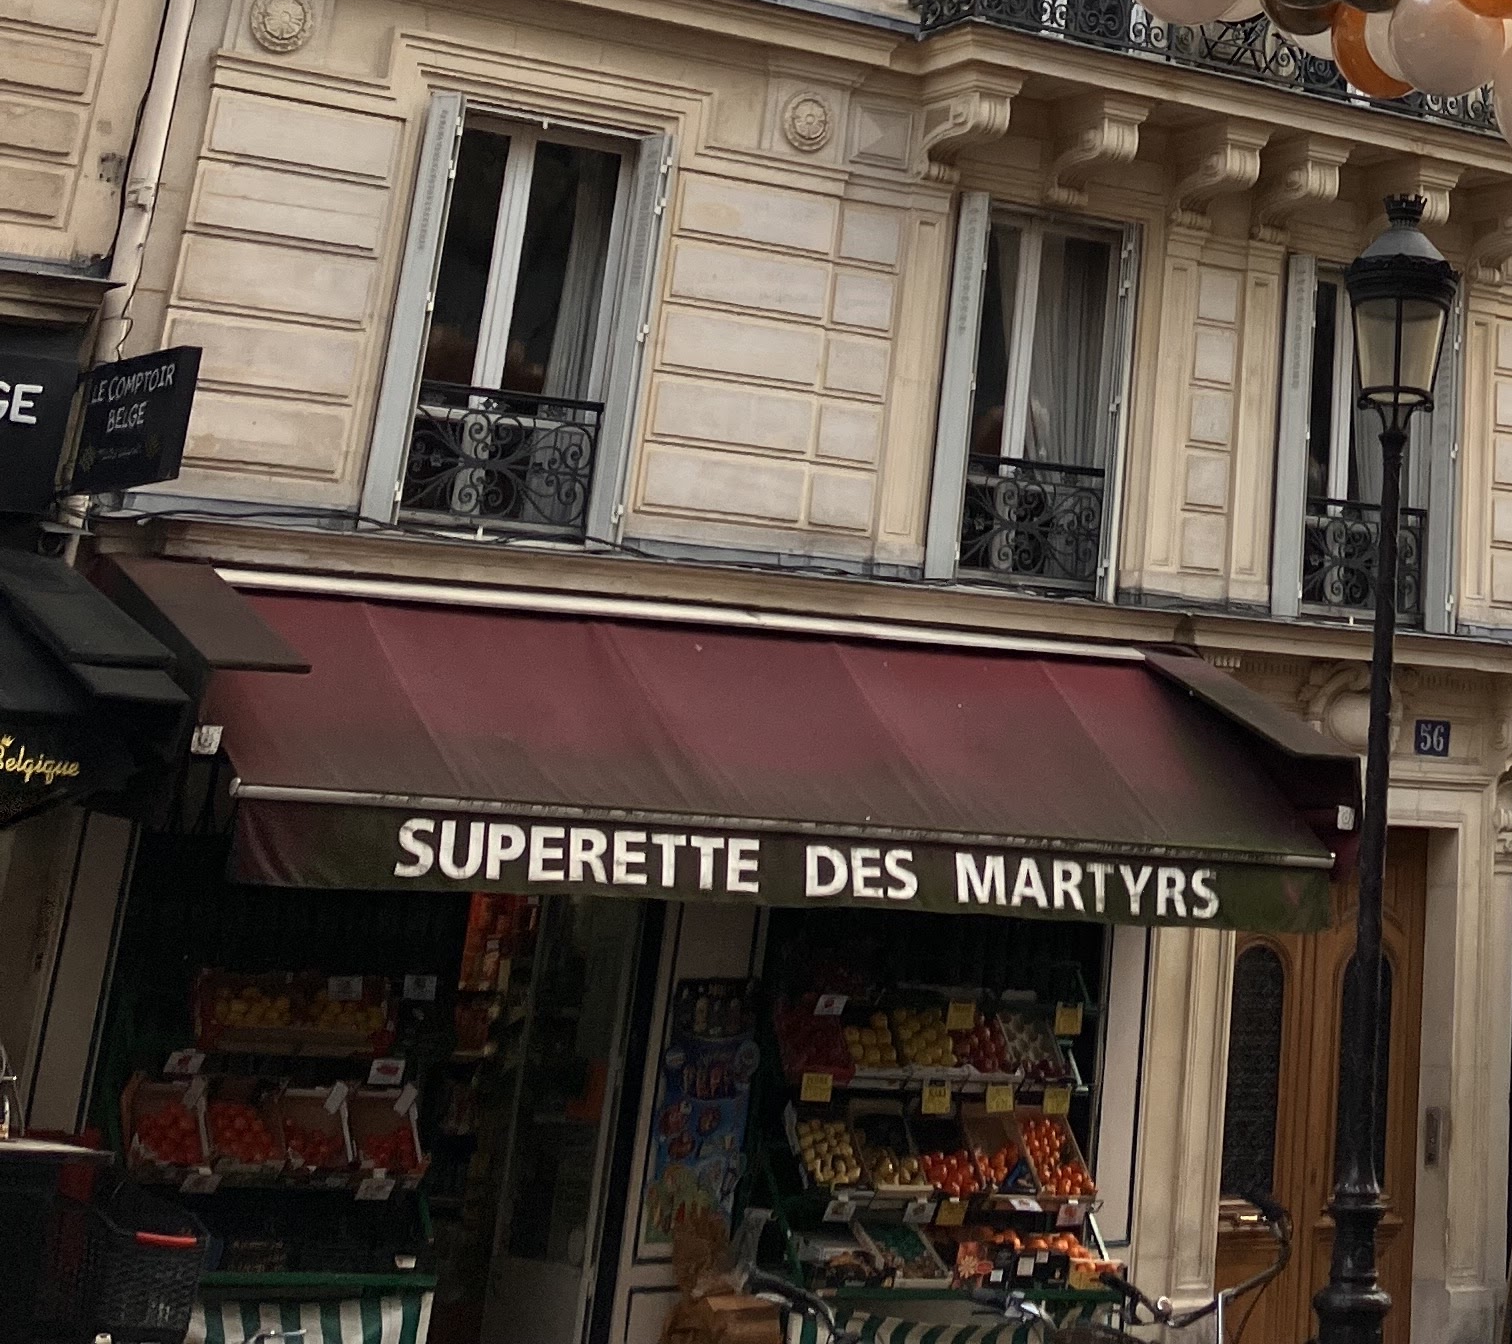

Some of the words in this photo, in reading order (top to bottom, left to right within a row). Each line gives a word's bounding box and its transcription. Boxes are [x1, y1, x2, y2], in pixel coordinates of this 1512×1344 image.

[91, 380, 108, 404] LE
[108, 363, 175, 402] COMPTOIR
[106, 400, 149, 433] BELGE
[1419, 723, 1445, 752] 56
[0, 744, 80, 785] elgique
[394, 818, 760, 894] SUPERETTE
[806, 844, 918, 900] DES
[955, 852, 1220, 920] MARTYRS
